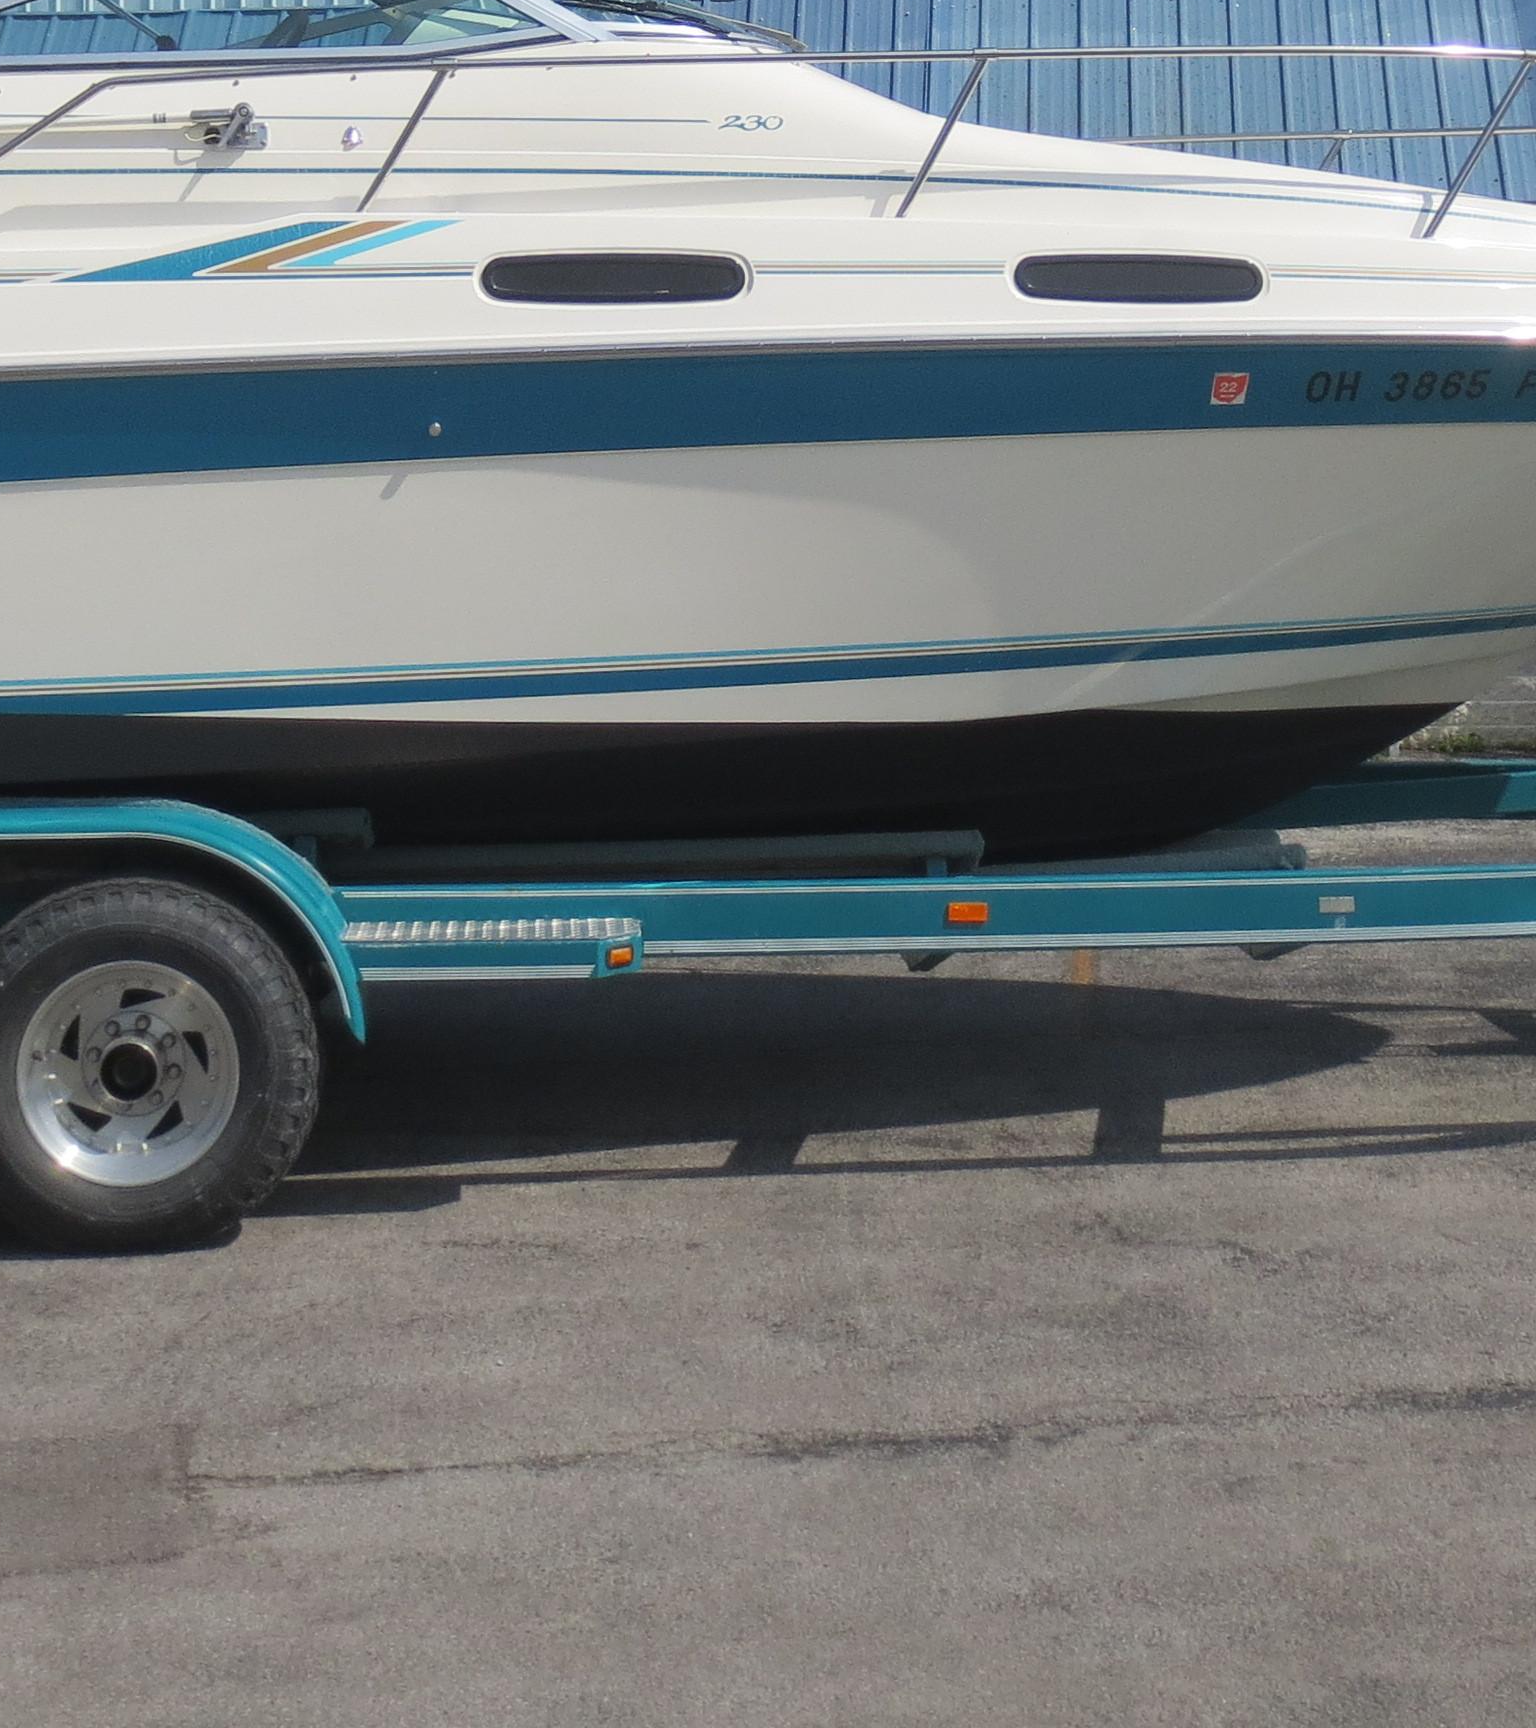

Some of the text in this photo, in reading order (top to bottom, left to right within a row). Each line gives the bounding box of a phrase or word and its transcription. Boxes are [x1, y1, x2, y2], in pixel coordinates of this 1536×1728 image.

[718, 114, 784, 132] 230
[1219, 381, 1238, 393] 22
[1306, 371, 1362, 403] OH
[1383, 369, 1492, 402] 3865
